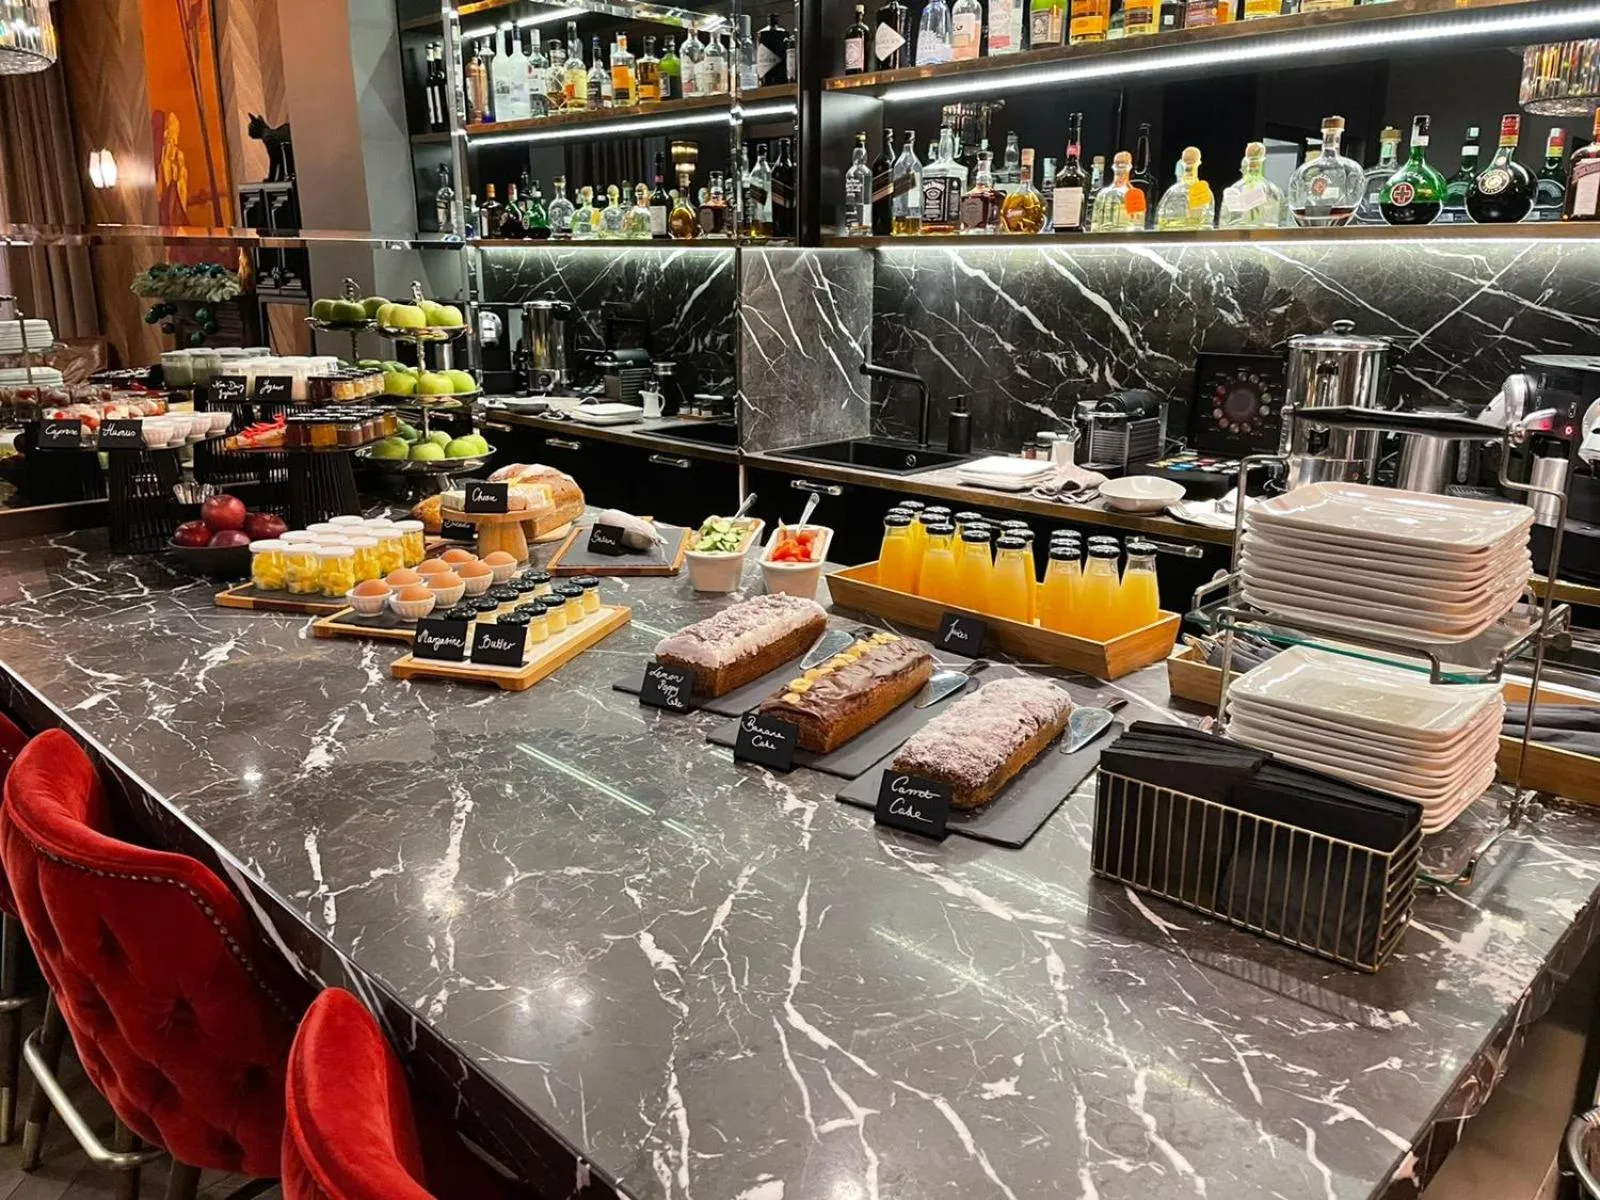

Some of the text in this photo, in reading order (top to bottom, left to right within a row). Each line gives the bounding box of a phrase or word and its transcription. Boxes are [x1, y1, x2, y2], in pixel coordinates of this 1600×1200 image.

[417, 629, 465, 651] Margarine
[478, 634, 516, 651] Butter
[648, 666, 684, 683] Lemon
[657, 679, 680, 698] Poppy
[666, 695, 684, 708] Cake
[741, 715, 786, 740] Banana
[751, 735, 777, 750] Cake
[891, 775, 941, 799] Carrot
[889, 797, 934, 823] Cake
